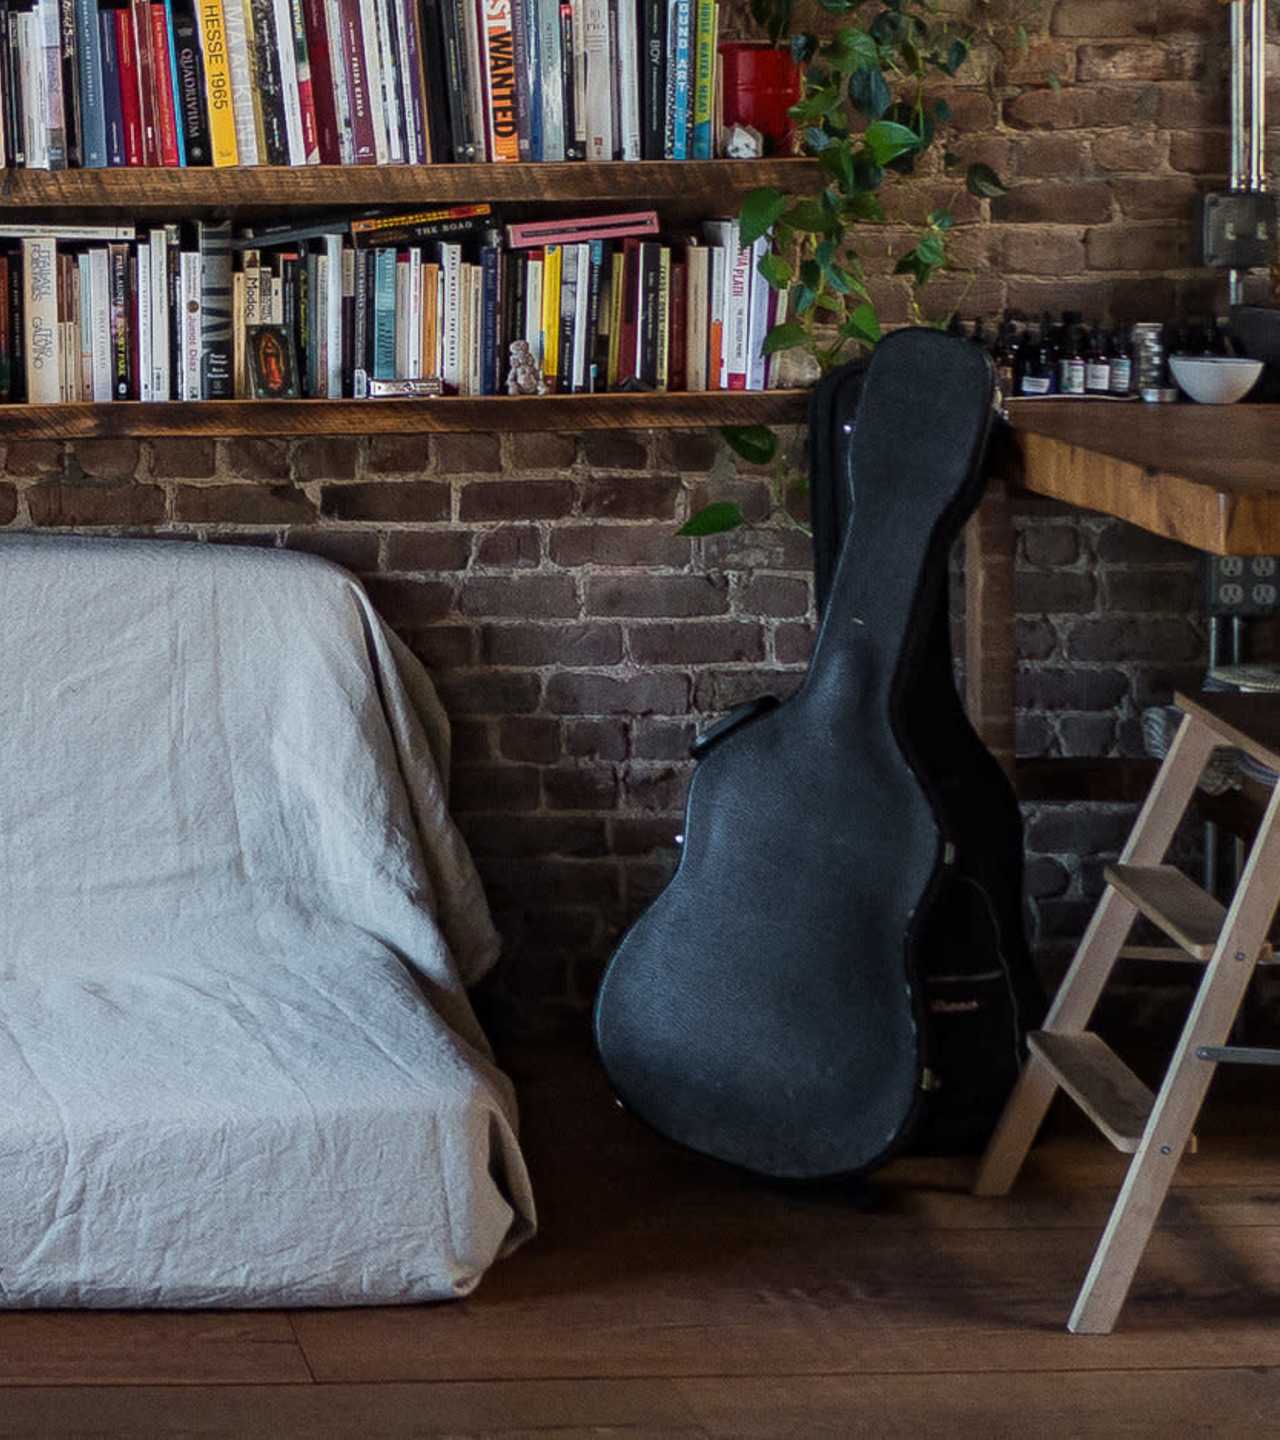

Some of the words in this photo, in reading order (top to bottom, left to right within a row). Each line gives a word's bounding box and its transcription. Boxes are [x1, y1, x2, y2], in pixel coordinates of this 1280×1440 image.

[203, 4, 220, 65] HESSE
[179, 48, 200, 138] QUADRIVIUM
[211, 72, 226, 110] 1965
[488, 32, 517, 138] WANTED
[245, 277, 258, 318] Modoc
